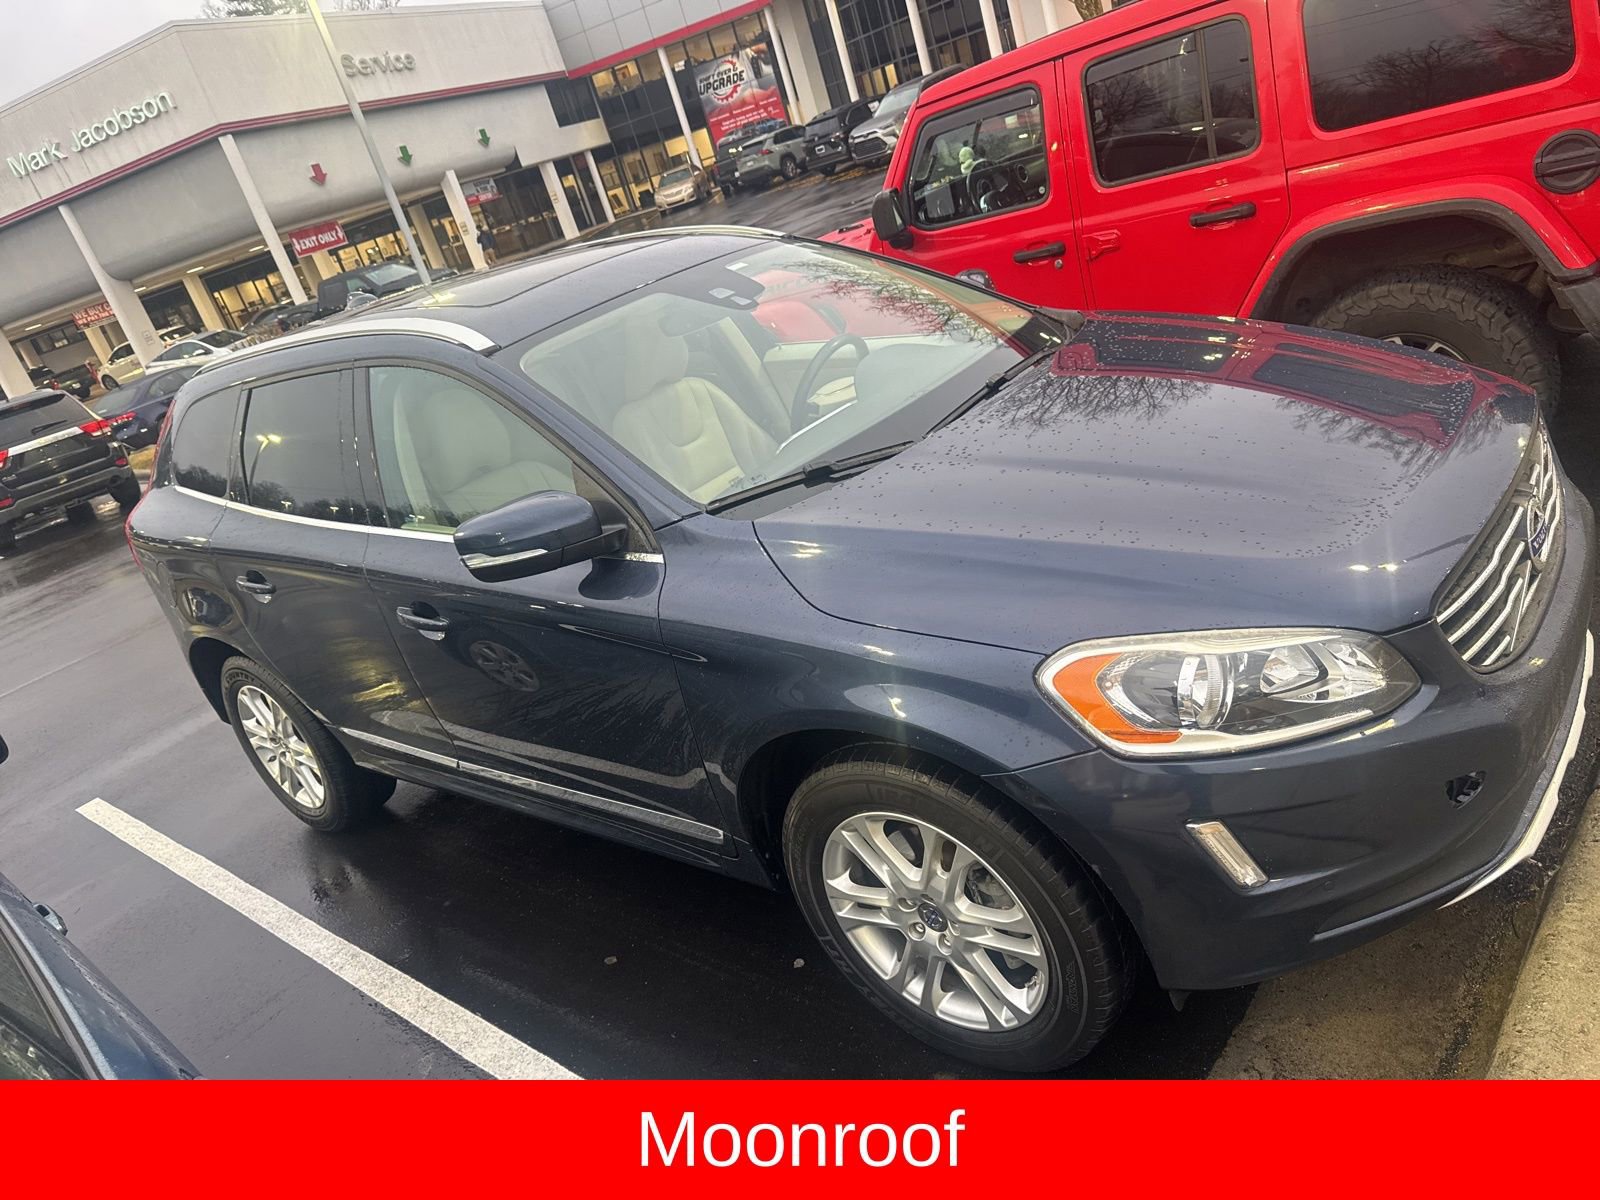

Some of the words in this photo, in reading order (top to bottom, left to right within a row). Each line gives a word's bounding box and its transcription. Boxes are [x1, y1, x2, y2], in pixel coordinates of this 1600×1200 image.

[341, 51, 416, 77] Service
[699, 73, 715, 83] SHIFT
[717, 68, 732, 78] OVER
[699, 70, 744, 96] UPGRADE
[6, 141, 68, 178] Mark
[71, 91, 177, 152] Jacobson
[299, 236, 318, 250] EXIT
[318, 230, 338, 244] ONLY
[72, 310, 88, 320] WE
[87, 304, 103, 314] BUY
